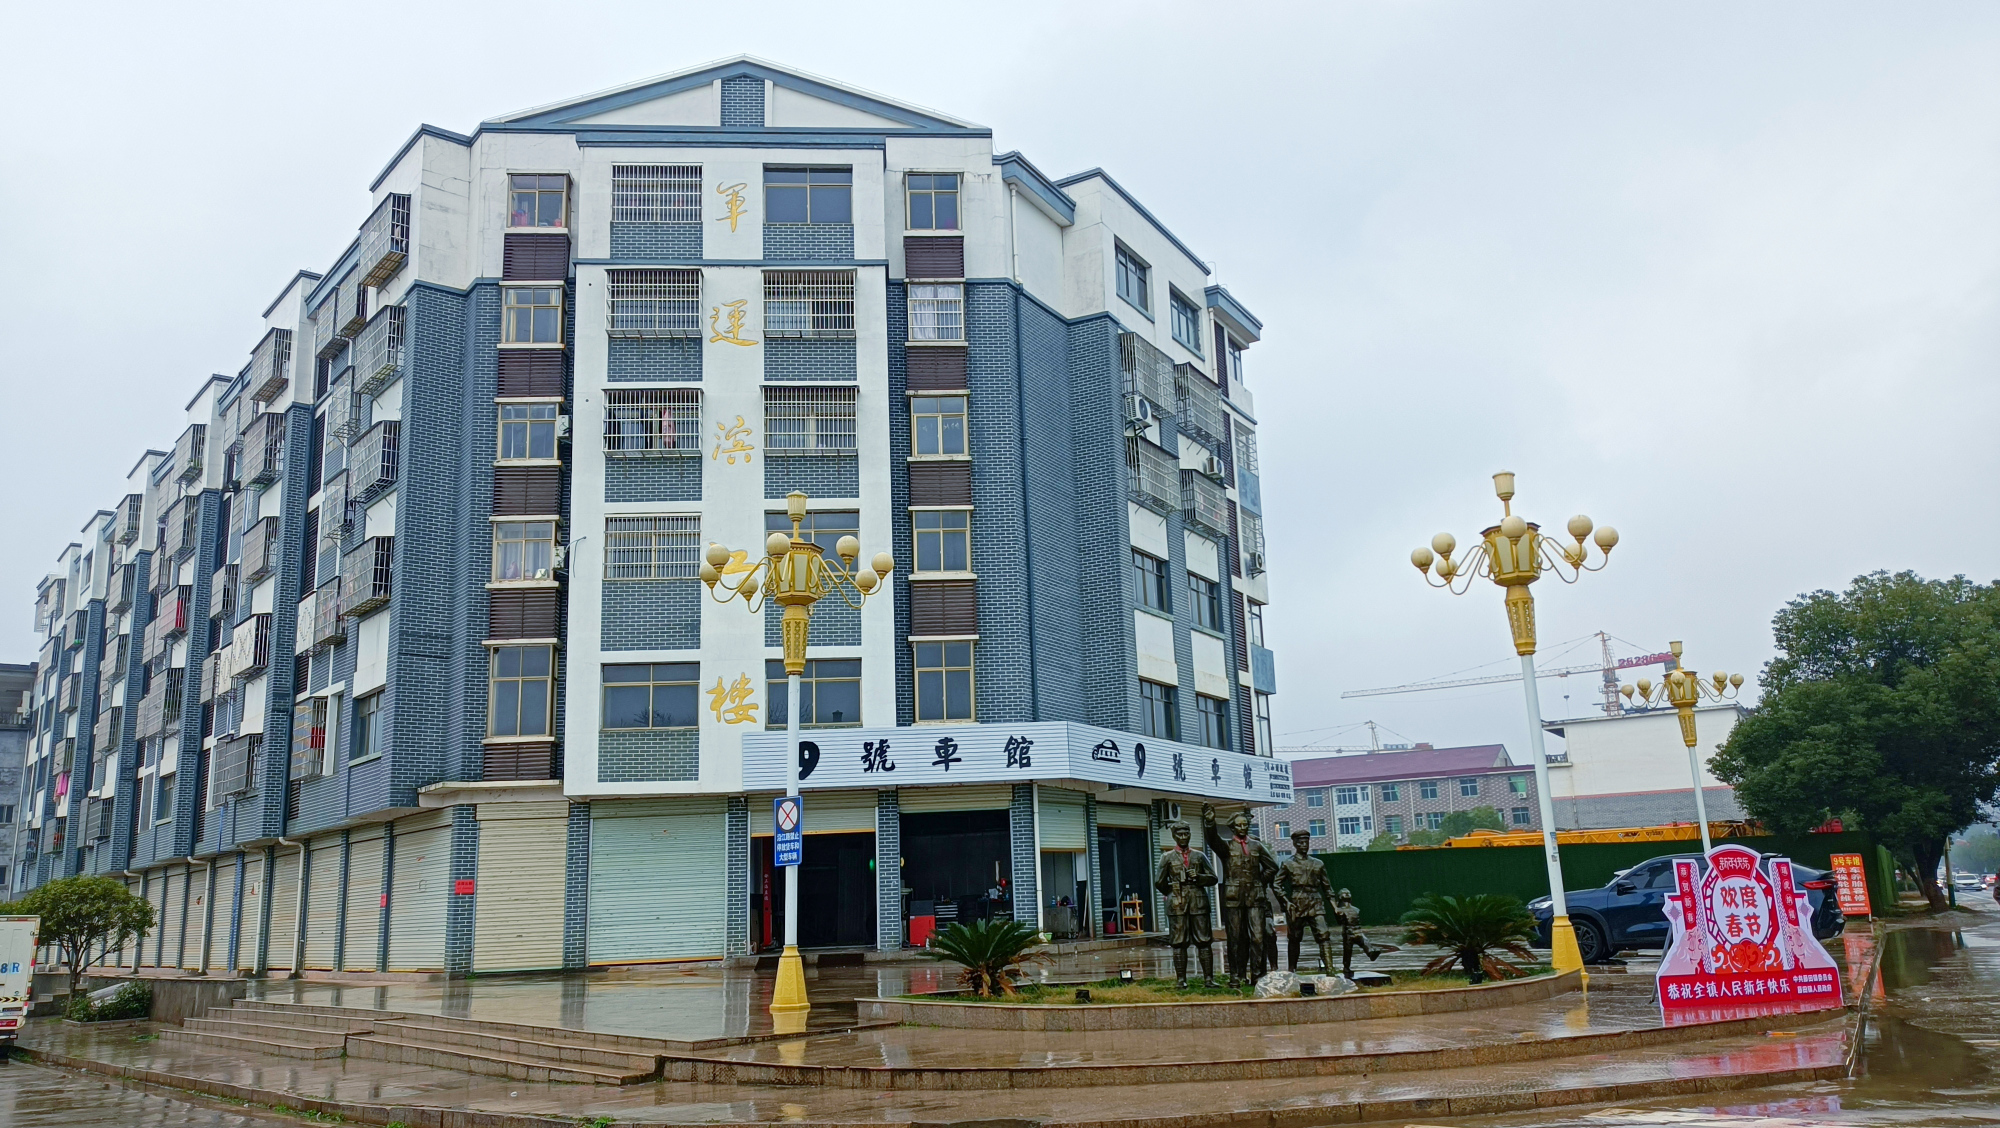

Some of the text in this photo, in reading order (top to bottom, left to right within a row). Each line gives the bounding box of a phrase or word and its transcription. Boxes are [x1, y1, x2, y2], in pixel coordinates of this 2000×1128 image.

[1718, 857, 1751, 871] 新年快乐
[1833, 856, 1861, 866] 9号车馆
[1720, 884, 1759, 910] 欢度
[1839, 887, 1865, 895] 美容
[1840, 894, 1866, 902] 维修
[1725, 912, 1762, 938] 春节
[1667, 977, 1791, 1000] 恭祝全镇人民新年快乐
